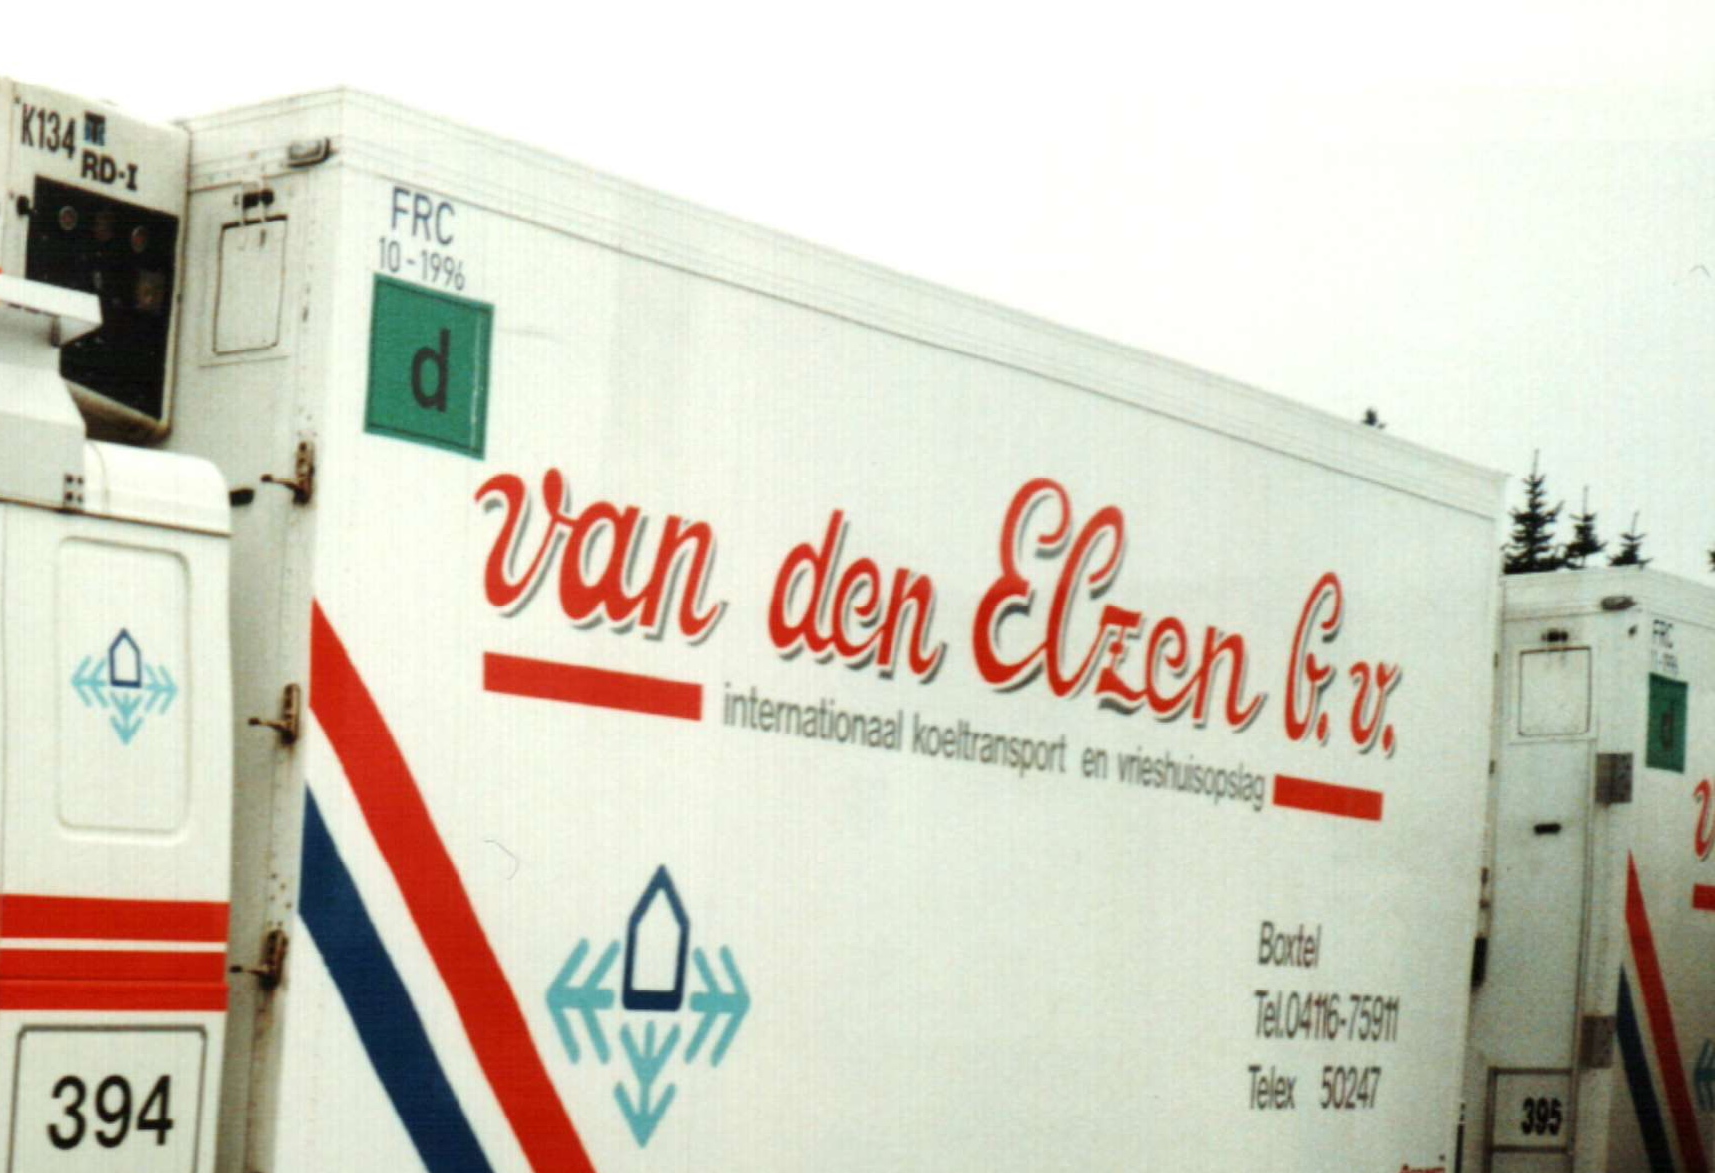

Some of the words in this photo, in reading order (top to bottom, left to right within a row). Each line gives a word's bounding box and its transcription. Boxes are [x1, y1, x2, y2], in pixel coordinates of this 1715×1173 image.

[21, 103, 76, 159] K134
[81, 149, 138, 191] RD-I
[391, 186, 455, 246] FRC
[410, 328, 451, 412] d
[475, 467, 728, 647] van
[768, 509, 948, 685] den
[973, 477, 1268, 734] Elzen
[723, 681, 904, 752] internationaal
[912, 711, 1066, 778] koeltransport
[1081, 746, 1108, 780] en
[1117, 746, 1266, 812] vrieshuisopslag
[1257, 920, 1322, 968] Boxtel
[47, 1074, 173, 1150] 394
[1248, 1064, 1297, 1110] Telex
[1320, 1064, 1381, 1110] 50247
[1521, 1097, 1563, 1135] 395
